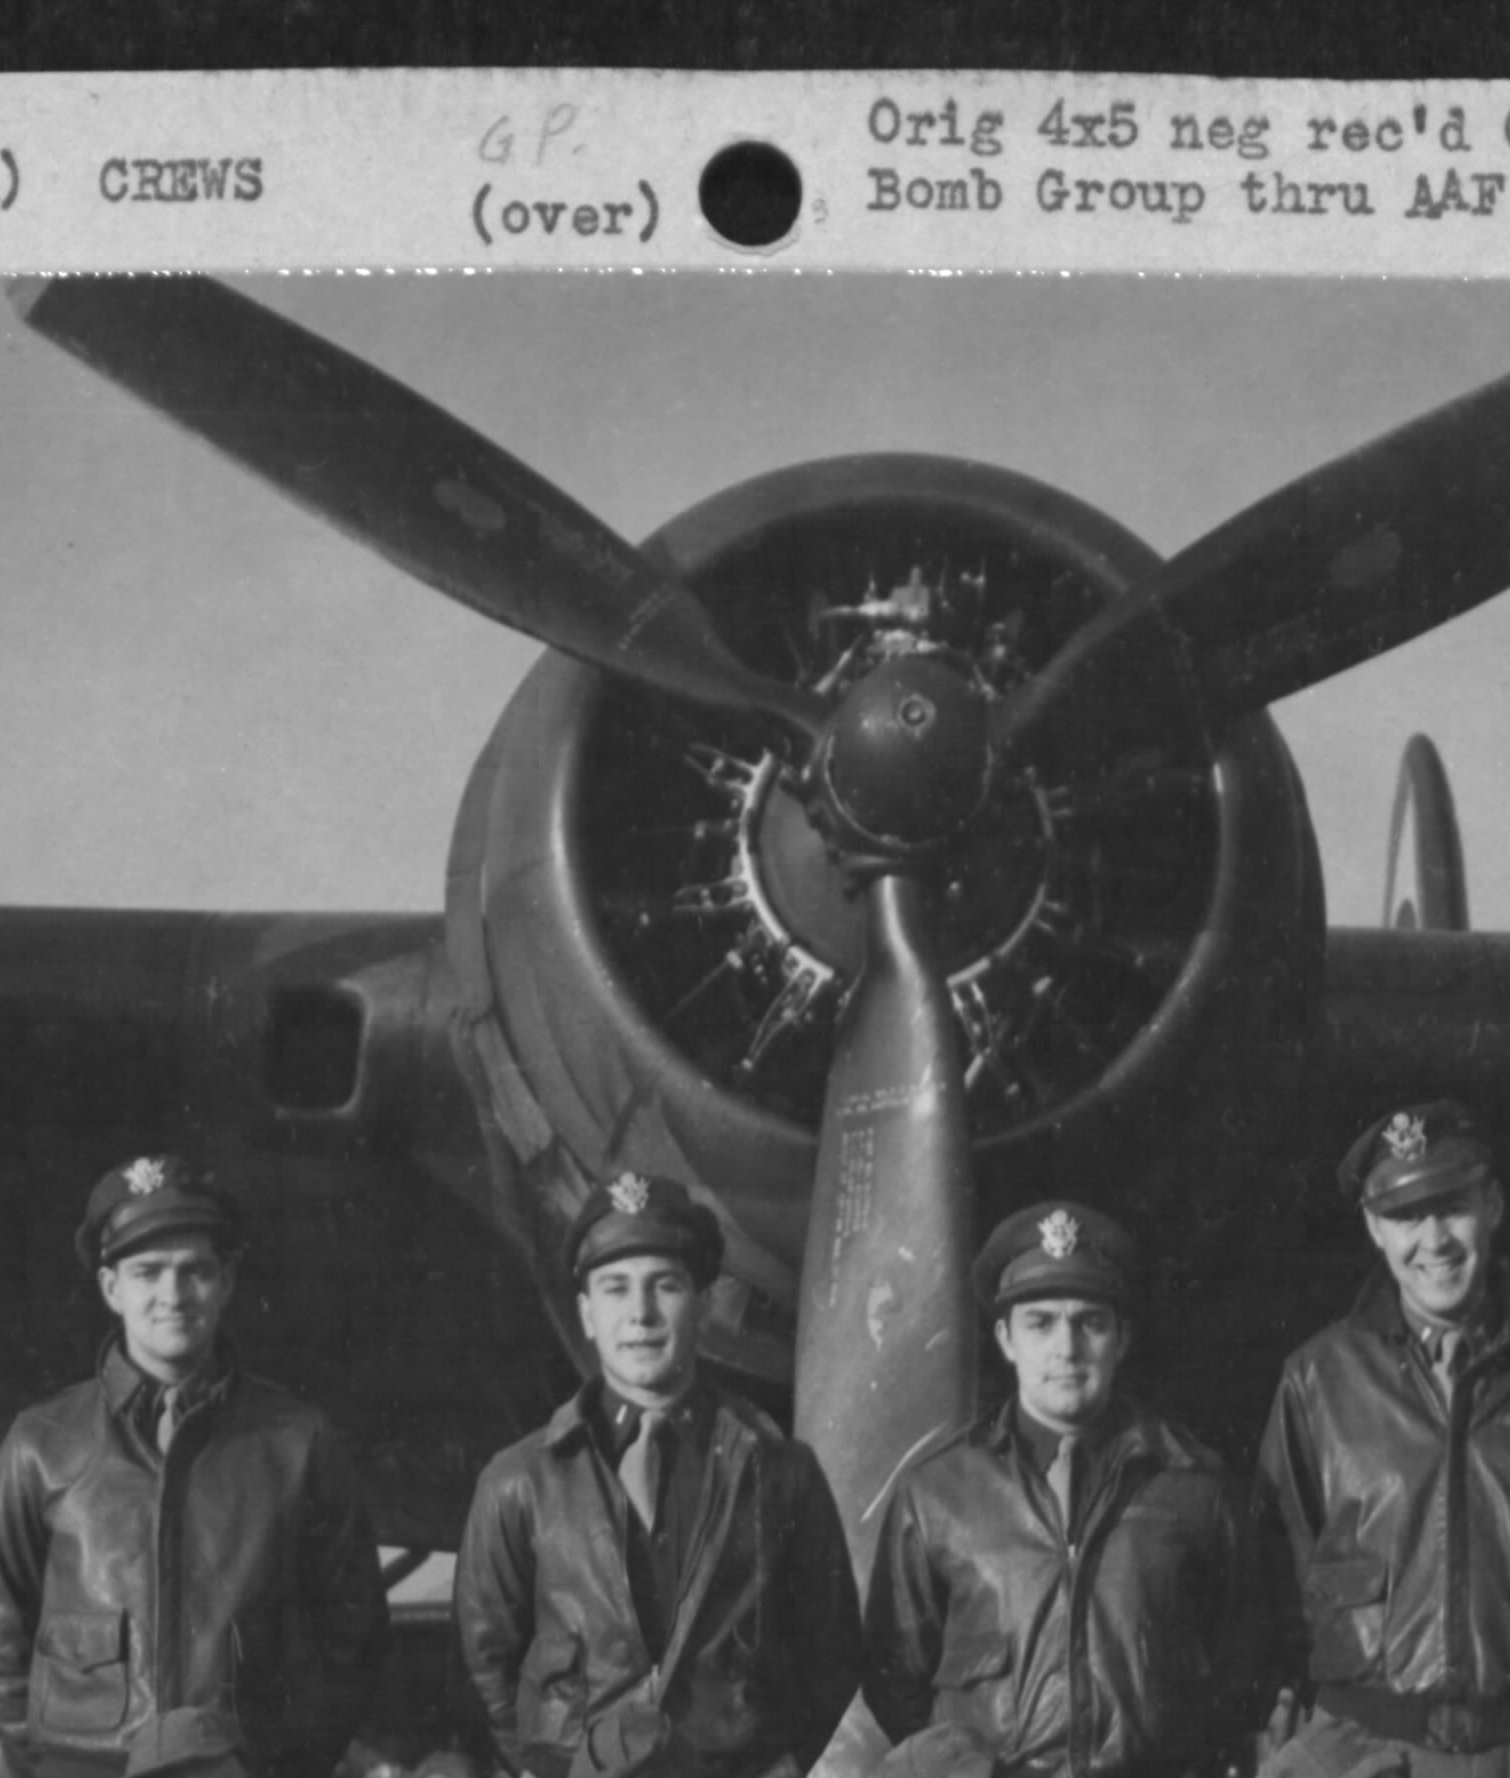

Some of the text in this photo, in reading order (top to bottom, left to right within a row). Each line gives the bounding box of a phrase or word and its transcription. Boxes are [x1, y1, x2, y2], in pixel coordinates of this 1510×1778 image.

[867, 97, 1005, 157] Orig
[1036, 98, 1140, 150] 4x5
[1169, 112, 1271, 158] neg
[1306, 102, 1473, 153] rec'd
[98, 157, 264, 204] CREWS
[866, 167, 1004, 212] Bomb
[1036, 167, 1206, 221] Group
[1239, 170, 1376, 216] thru
[1403, 168, 1507, 220] AAF
[472, 179, 660, 246] (over)
